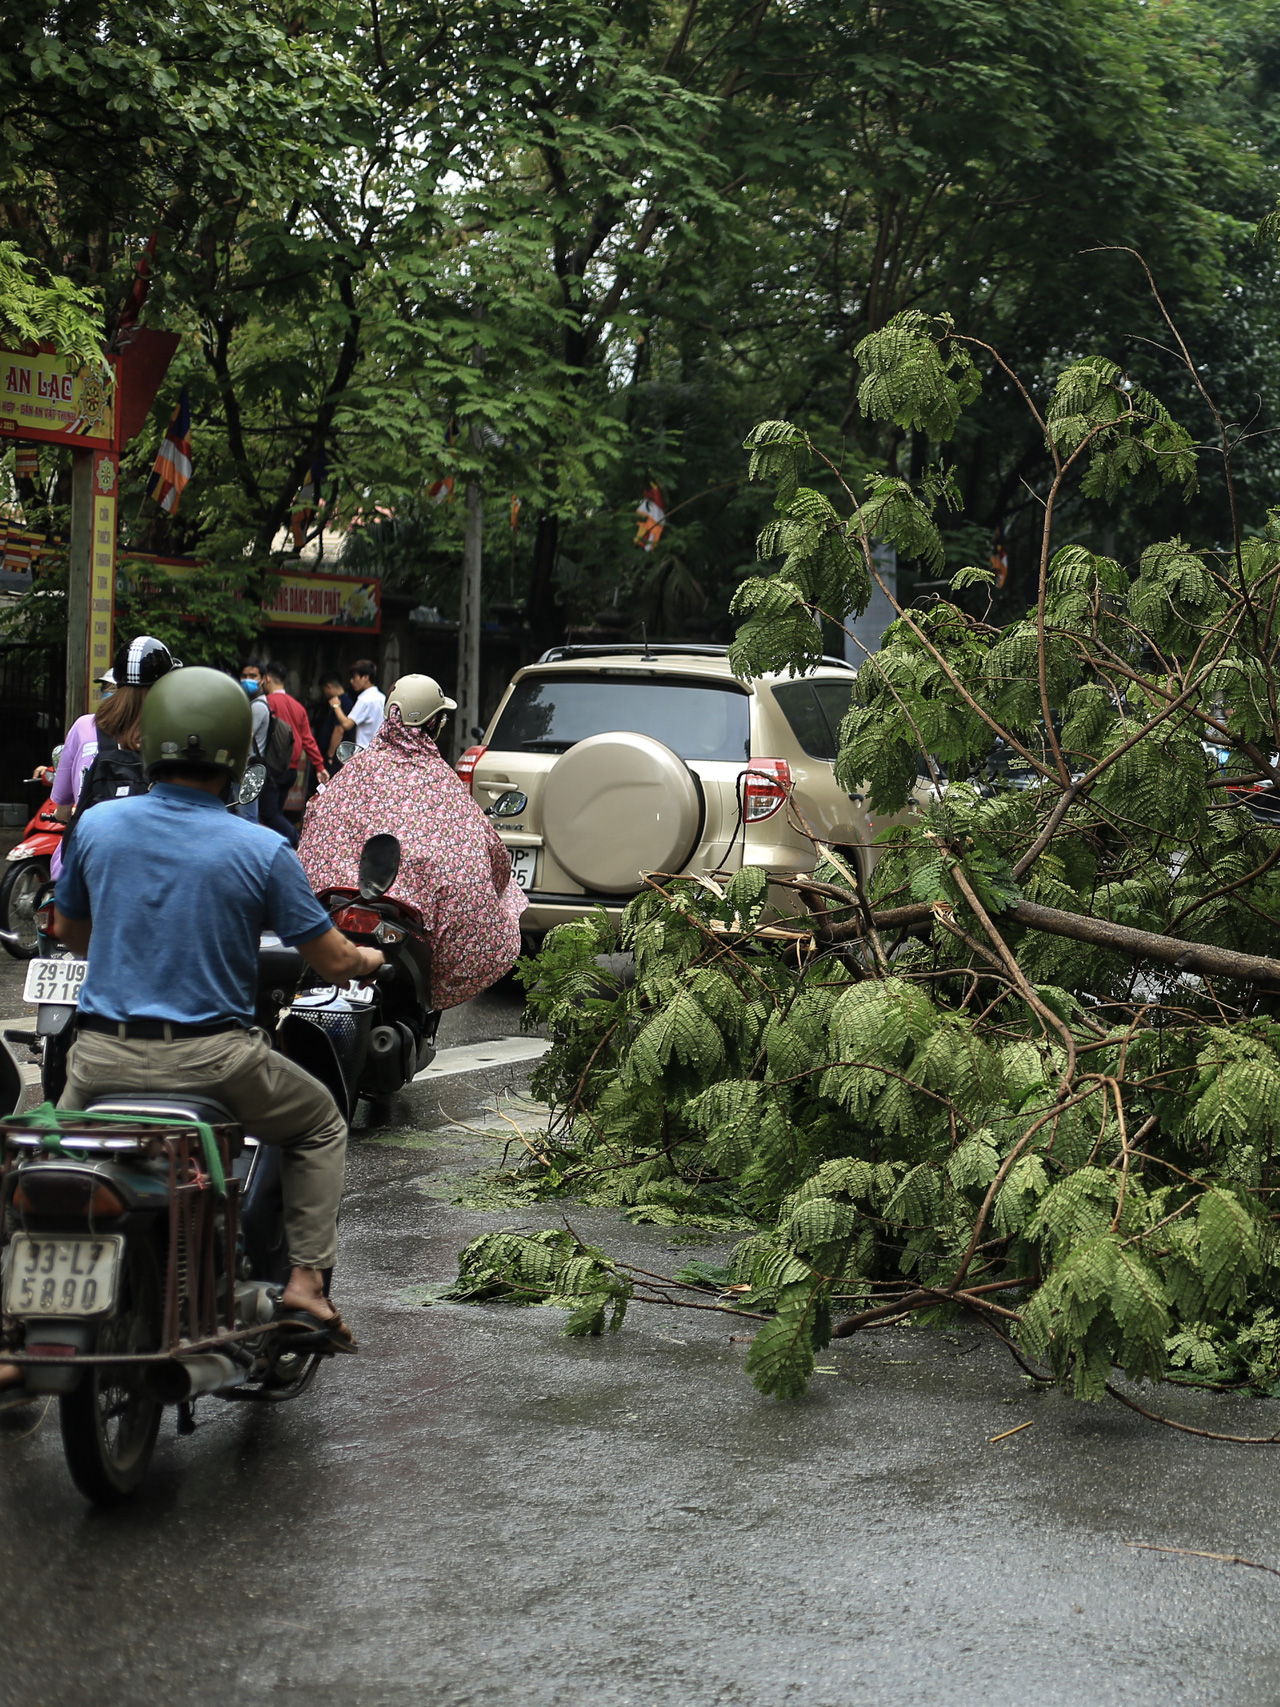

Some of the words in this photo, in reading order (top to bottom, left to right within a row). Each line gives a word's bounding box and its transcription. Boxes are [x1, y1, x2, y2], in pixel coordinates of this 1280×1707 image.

[5, 364, 31, 395] AN
[37, 369, 73, 406] LẠC
[38, 964, 86, 982] 29-U9
[24, 1243, 103, 1275] 33-L7
